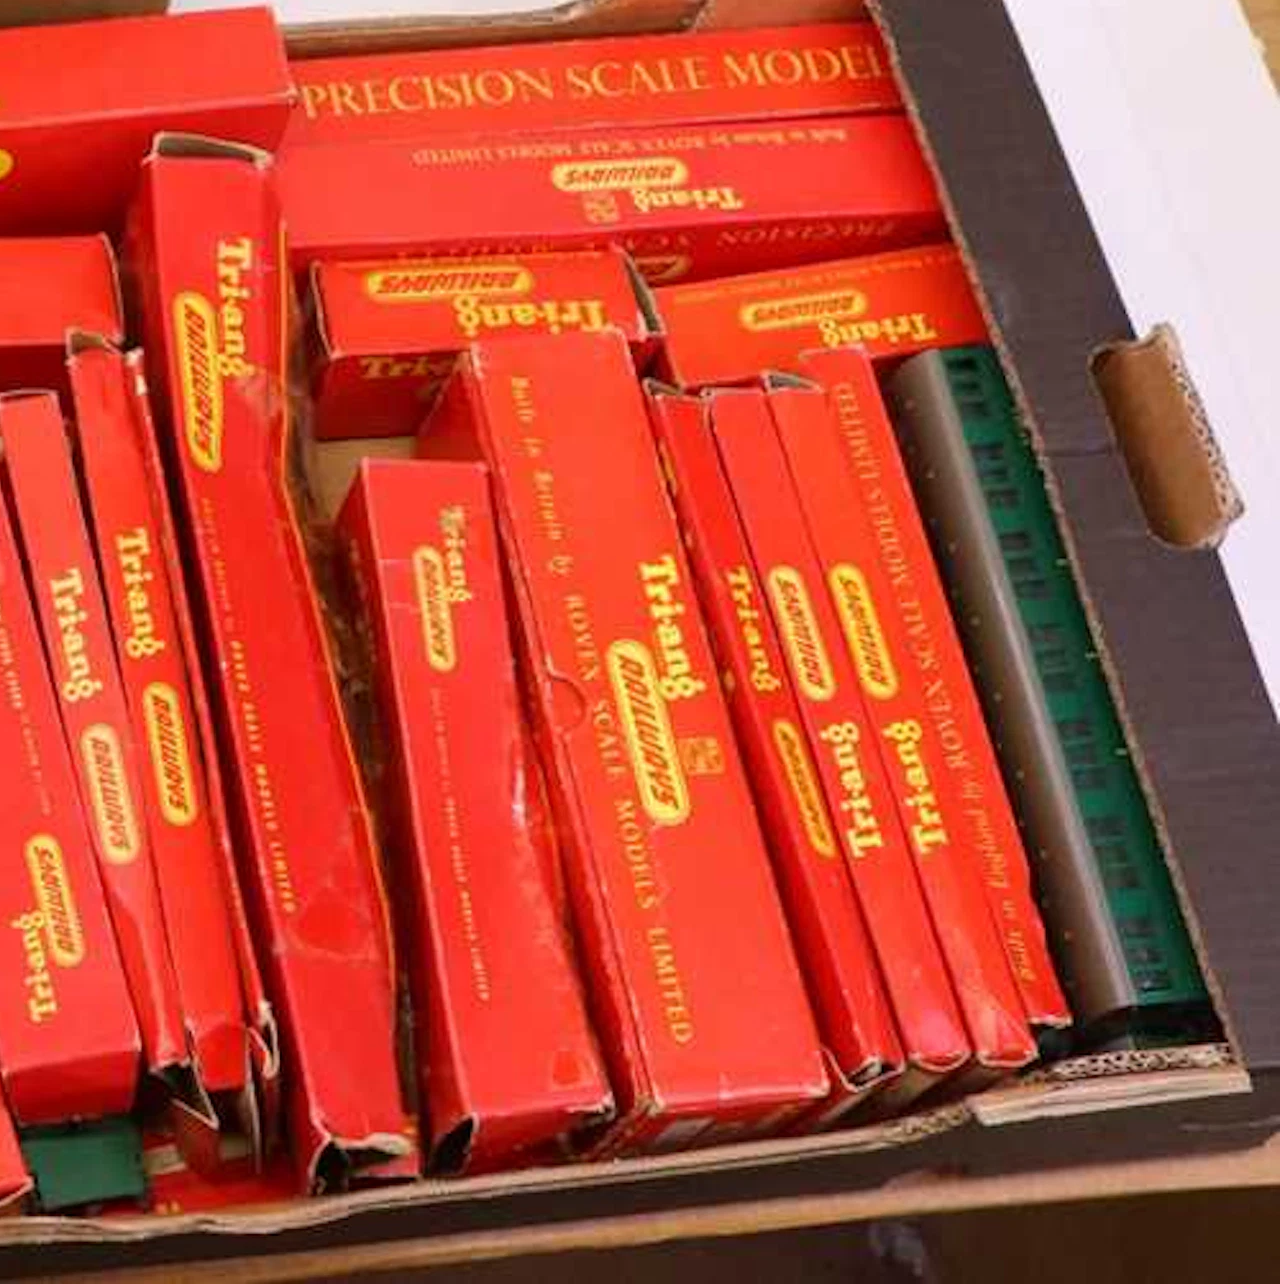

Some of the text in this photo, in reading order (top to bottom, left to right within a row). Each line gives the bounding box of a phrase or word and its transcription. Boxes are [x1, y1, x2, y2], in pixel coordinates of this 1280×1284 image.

[303, 67, 554, 118] PRECISION
[565, 56, 712, 99] SCALE
[49, 566, 104, 703] Tri-ang
[639, 554, 706, 701] Tri-ang
[617, 652, 681, 812] RAILWAYS
[819, 719, 884, 859] Tri-ang
[882, 718, 949, 856] Tri-ang
[591, 699, 627, 783] SCALE
[614, 797, 659, 910] MODELS
[647, 925, 695, 1046] LIMITED
